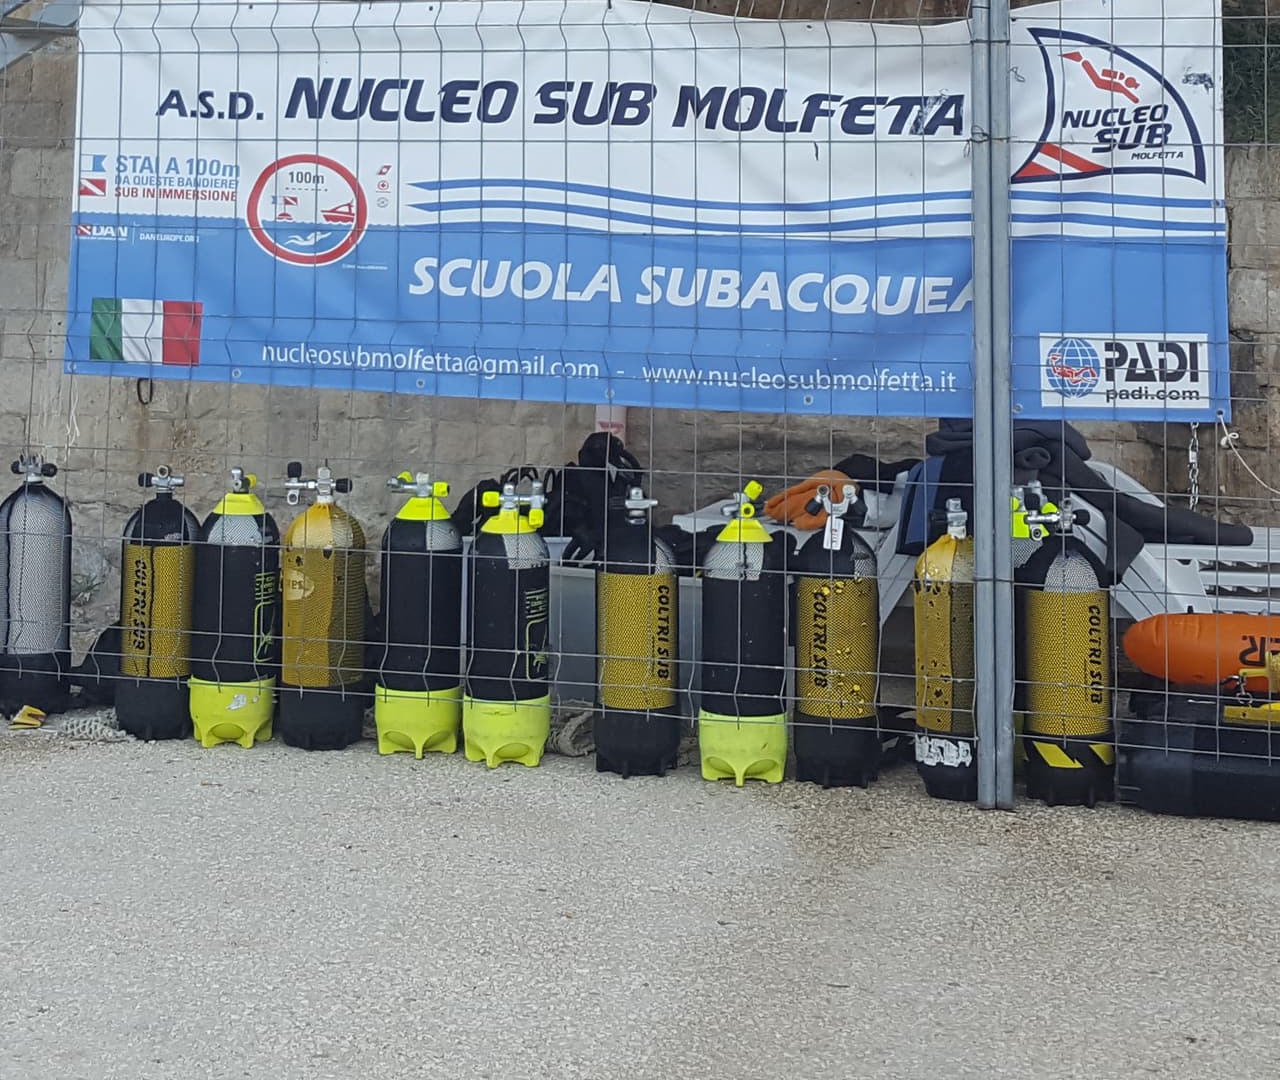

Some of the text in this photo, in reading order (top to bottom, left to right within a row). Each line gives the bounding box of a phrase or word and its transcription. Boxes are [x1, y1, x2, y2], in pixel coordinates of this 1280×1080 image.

[156, 89, 264, 121] A.S.D.
[284, 77, 519, 124] NUCLEO
[533, 80, 657, 126] SUB
[1062, 104, 1169, 129] NUCLEO
[1092, 122, 1173, 153] SUB
[165, 157, 180, 175] A
[186, 158, 240, 178] 100m
[1131, 151, 1184, 161] MOLFETTA
[115, 176, 130, 186] DA
[133, 176, 175, 187] QUESTE
[288, 171, 325, 185] 100m
[114, 187, 237, 202] SUB IN IMMERSIONE
[408, 257, 621, 304] SCUOLA
[262, 344, 599, 381] nucleosubmolfetta@gmail.com
[642, 365, 957, 393] www.nucleosubmolfetta.it
[1104, 341, 1200, 383] PADI
[1106, 386, 1200, 404] padi.com
[657, 585, 670, 680] COLTRI SUB
[813, 592, 828, 688] COLTRI SUB
[1088, 605, 1105, 705] COLTRI SUB
